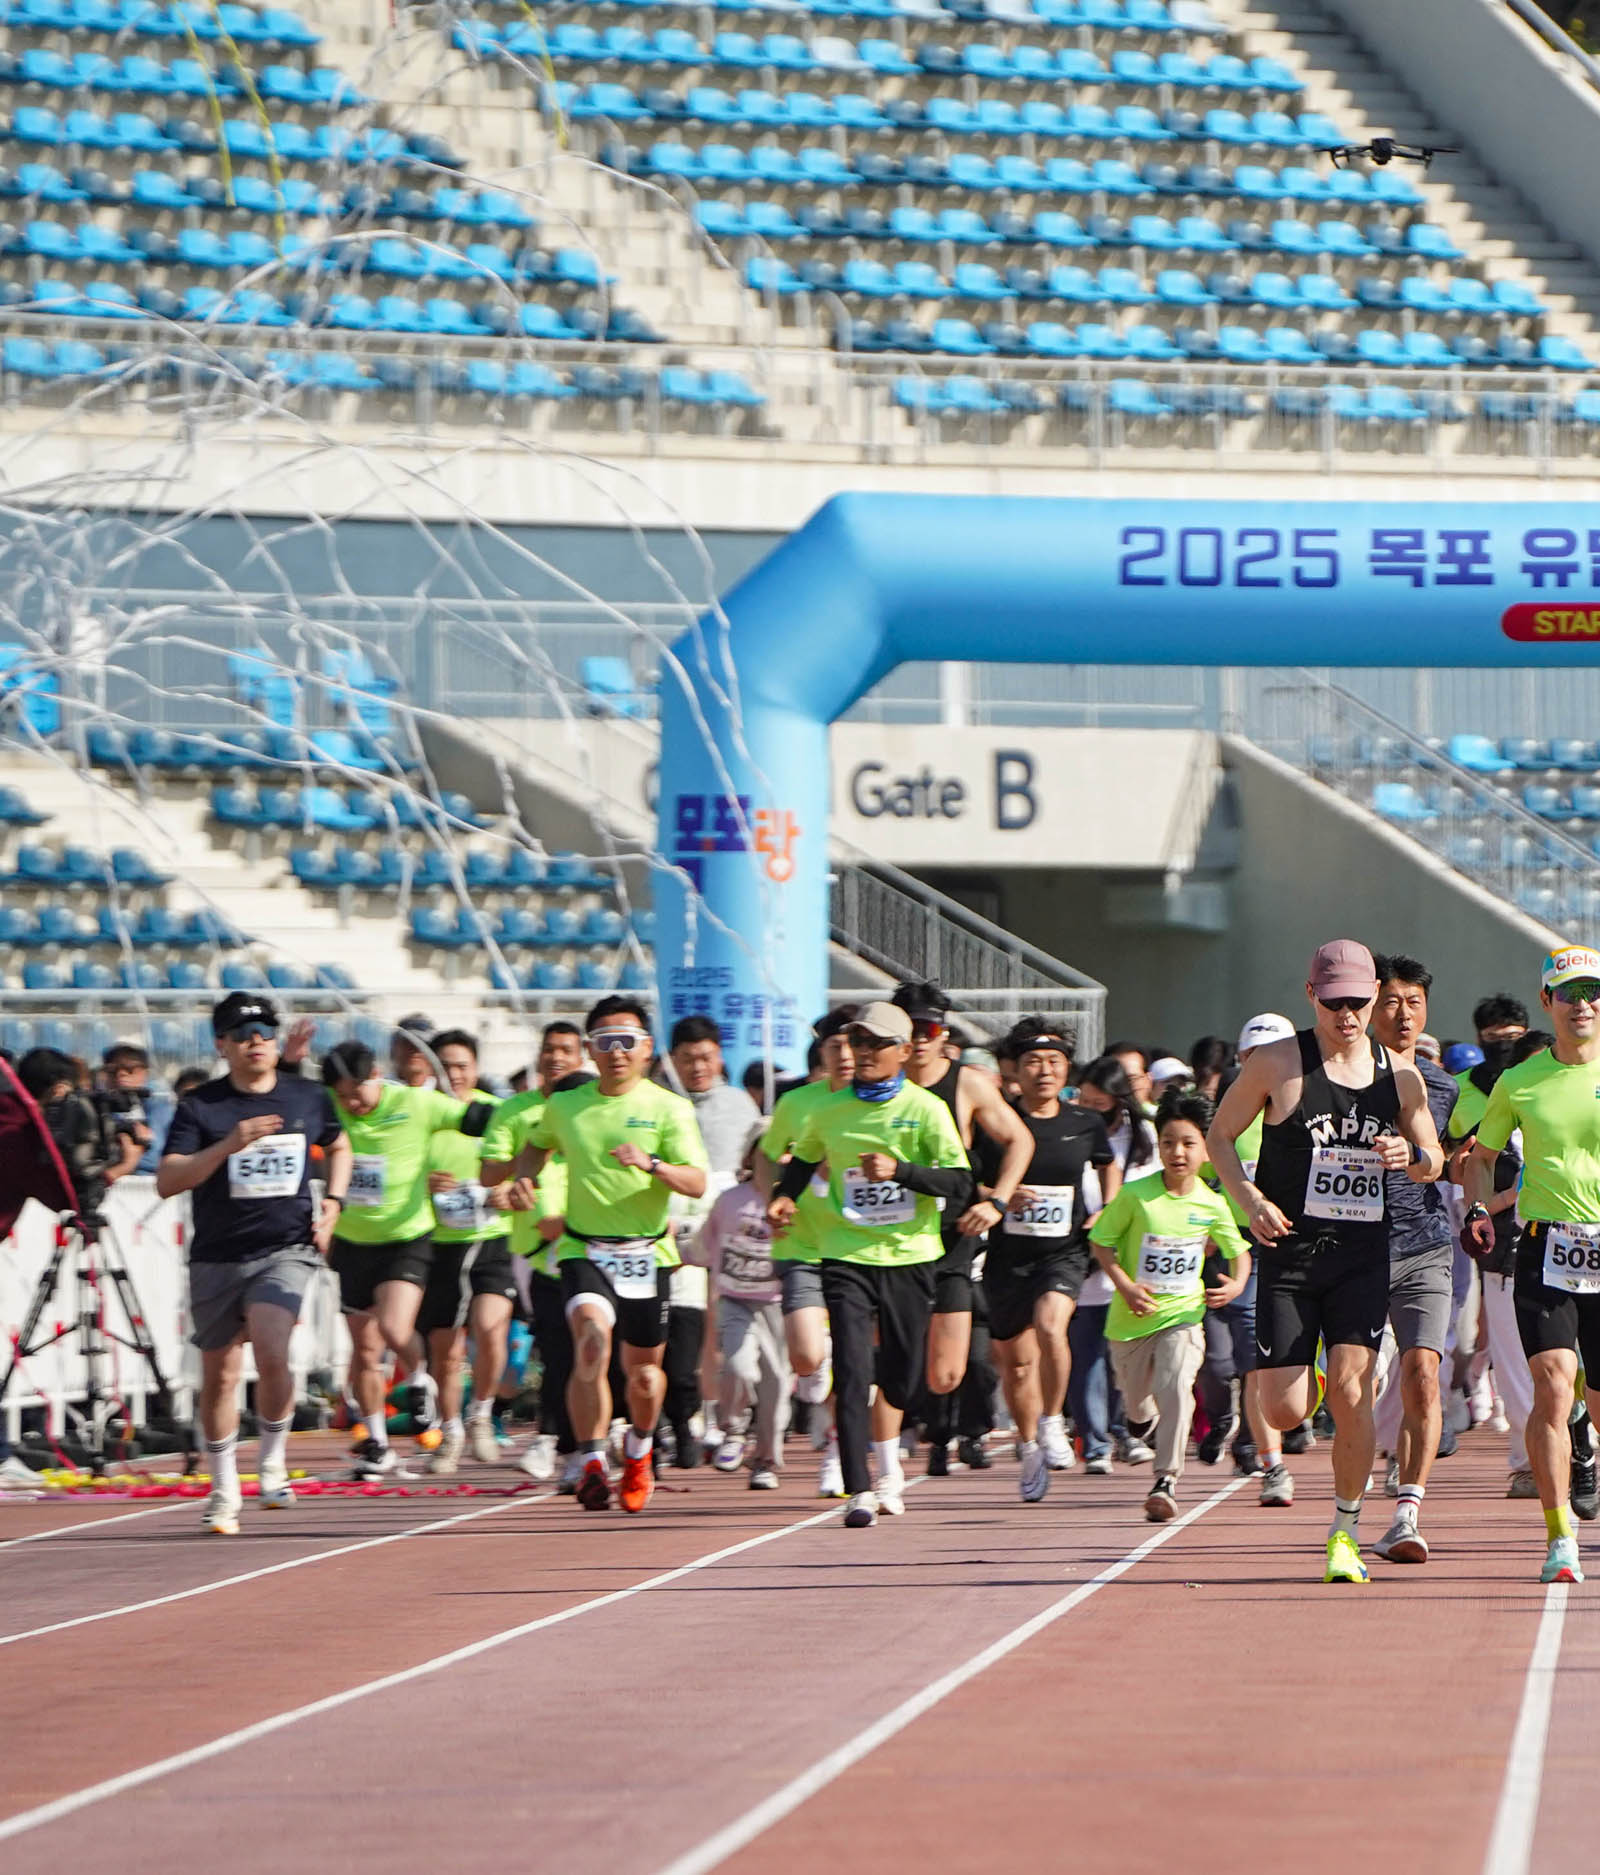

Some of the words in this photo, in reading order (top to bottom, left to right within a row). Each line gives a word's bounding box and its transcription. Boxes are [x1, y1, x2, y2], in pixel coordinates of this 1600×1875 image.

[1119, 526, 1340, 588] 2025
[1368, 528, 1495, 588] 목포
[849, 761, 966, 820] Gate
[992, 747, 1038, 830] B
[1555, 952, 1599, 971] ciele
[1304, 1112, 1333, 1130] Mokpo
[239, 1156, 297, 1177] 5415
[1313, 1171, 1380, 1198] 5066
[1144, 1254, 1197, 1275] 5364
